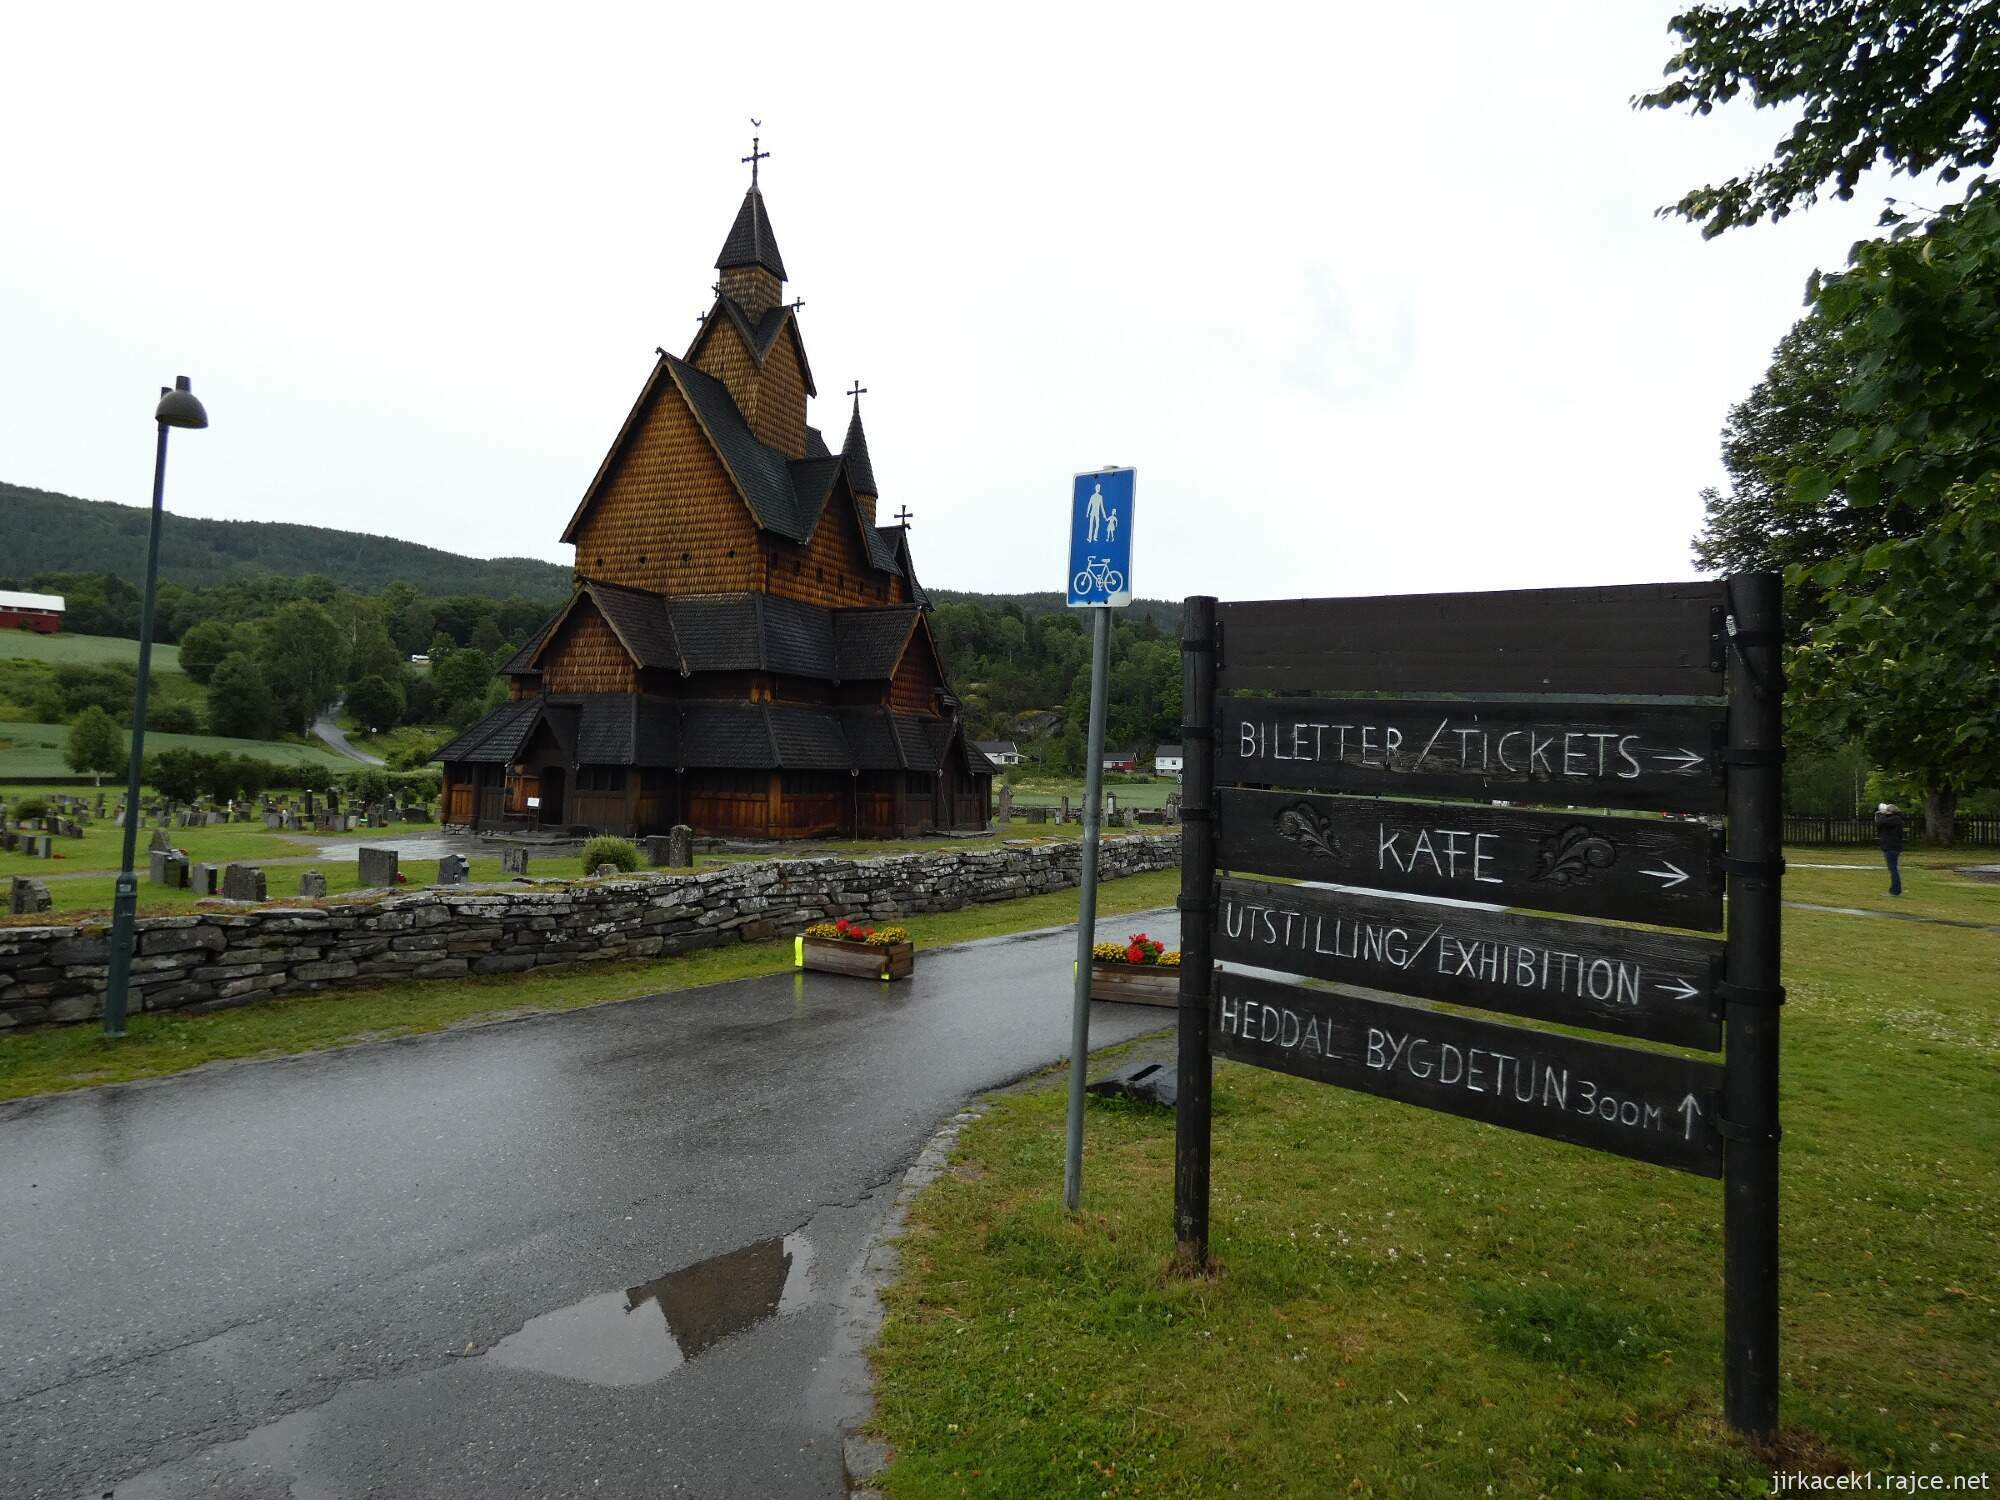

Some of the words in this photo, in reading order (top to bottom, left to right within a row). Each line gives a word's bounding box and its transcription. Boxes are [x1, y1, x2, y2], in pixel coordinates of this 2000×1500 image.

[1379, 822, 1504, 884] KAFE
[1220, 995, 1343, 1060] HEDDAL
[1365, 1027, 1568, 1111] BYGDETUN
